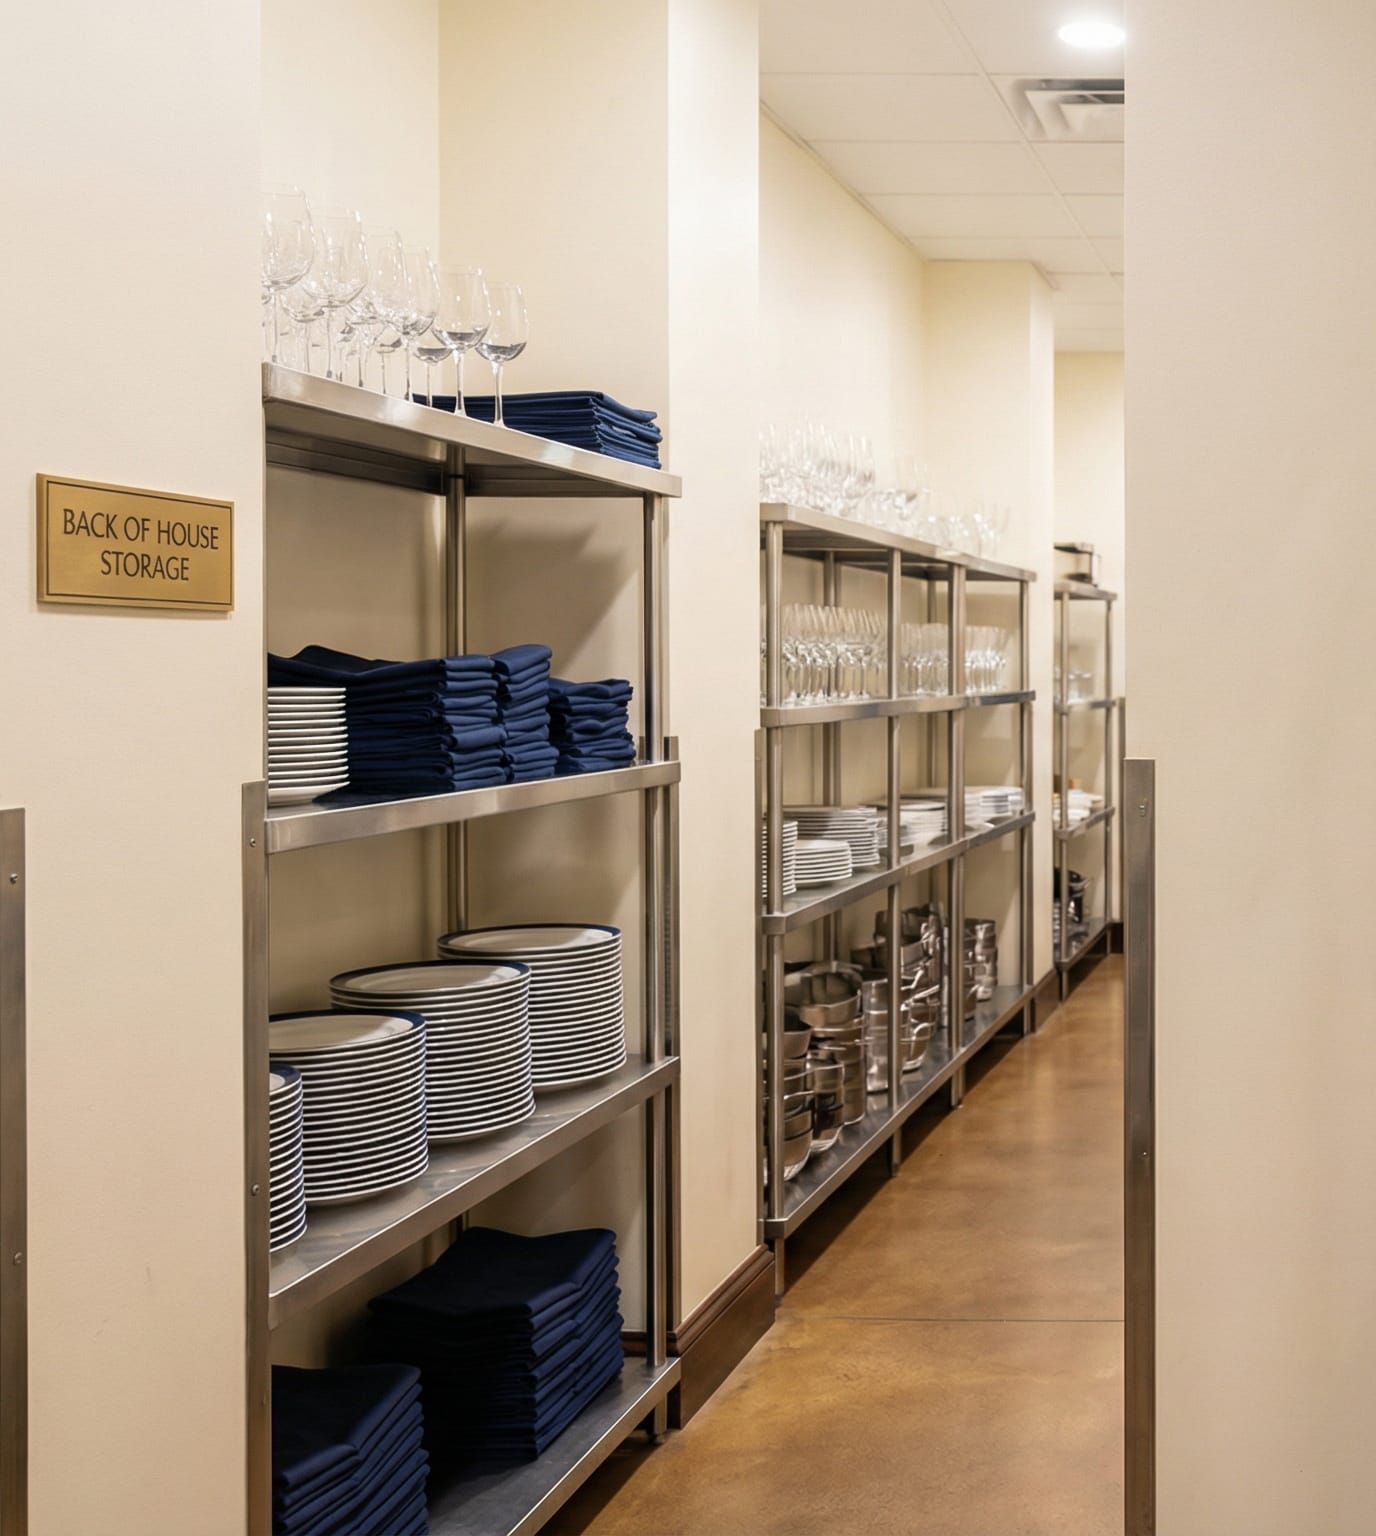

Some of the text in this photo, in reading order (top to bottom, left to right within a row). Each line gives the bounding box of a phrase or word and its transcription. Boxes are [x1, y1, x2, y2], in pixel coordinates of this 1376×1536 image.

[63, 508, 219, 550] BACK OF HOUSE
[100, 550, 190, 581] STORAGE
